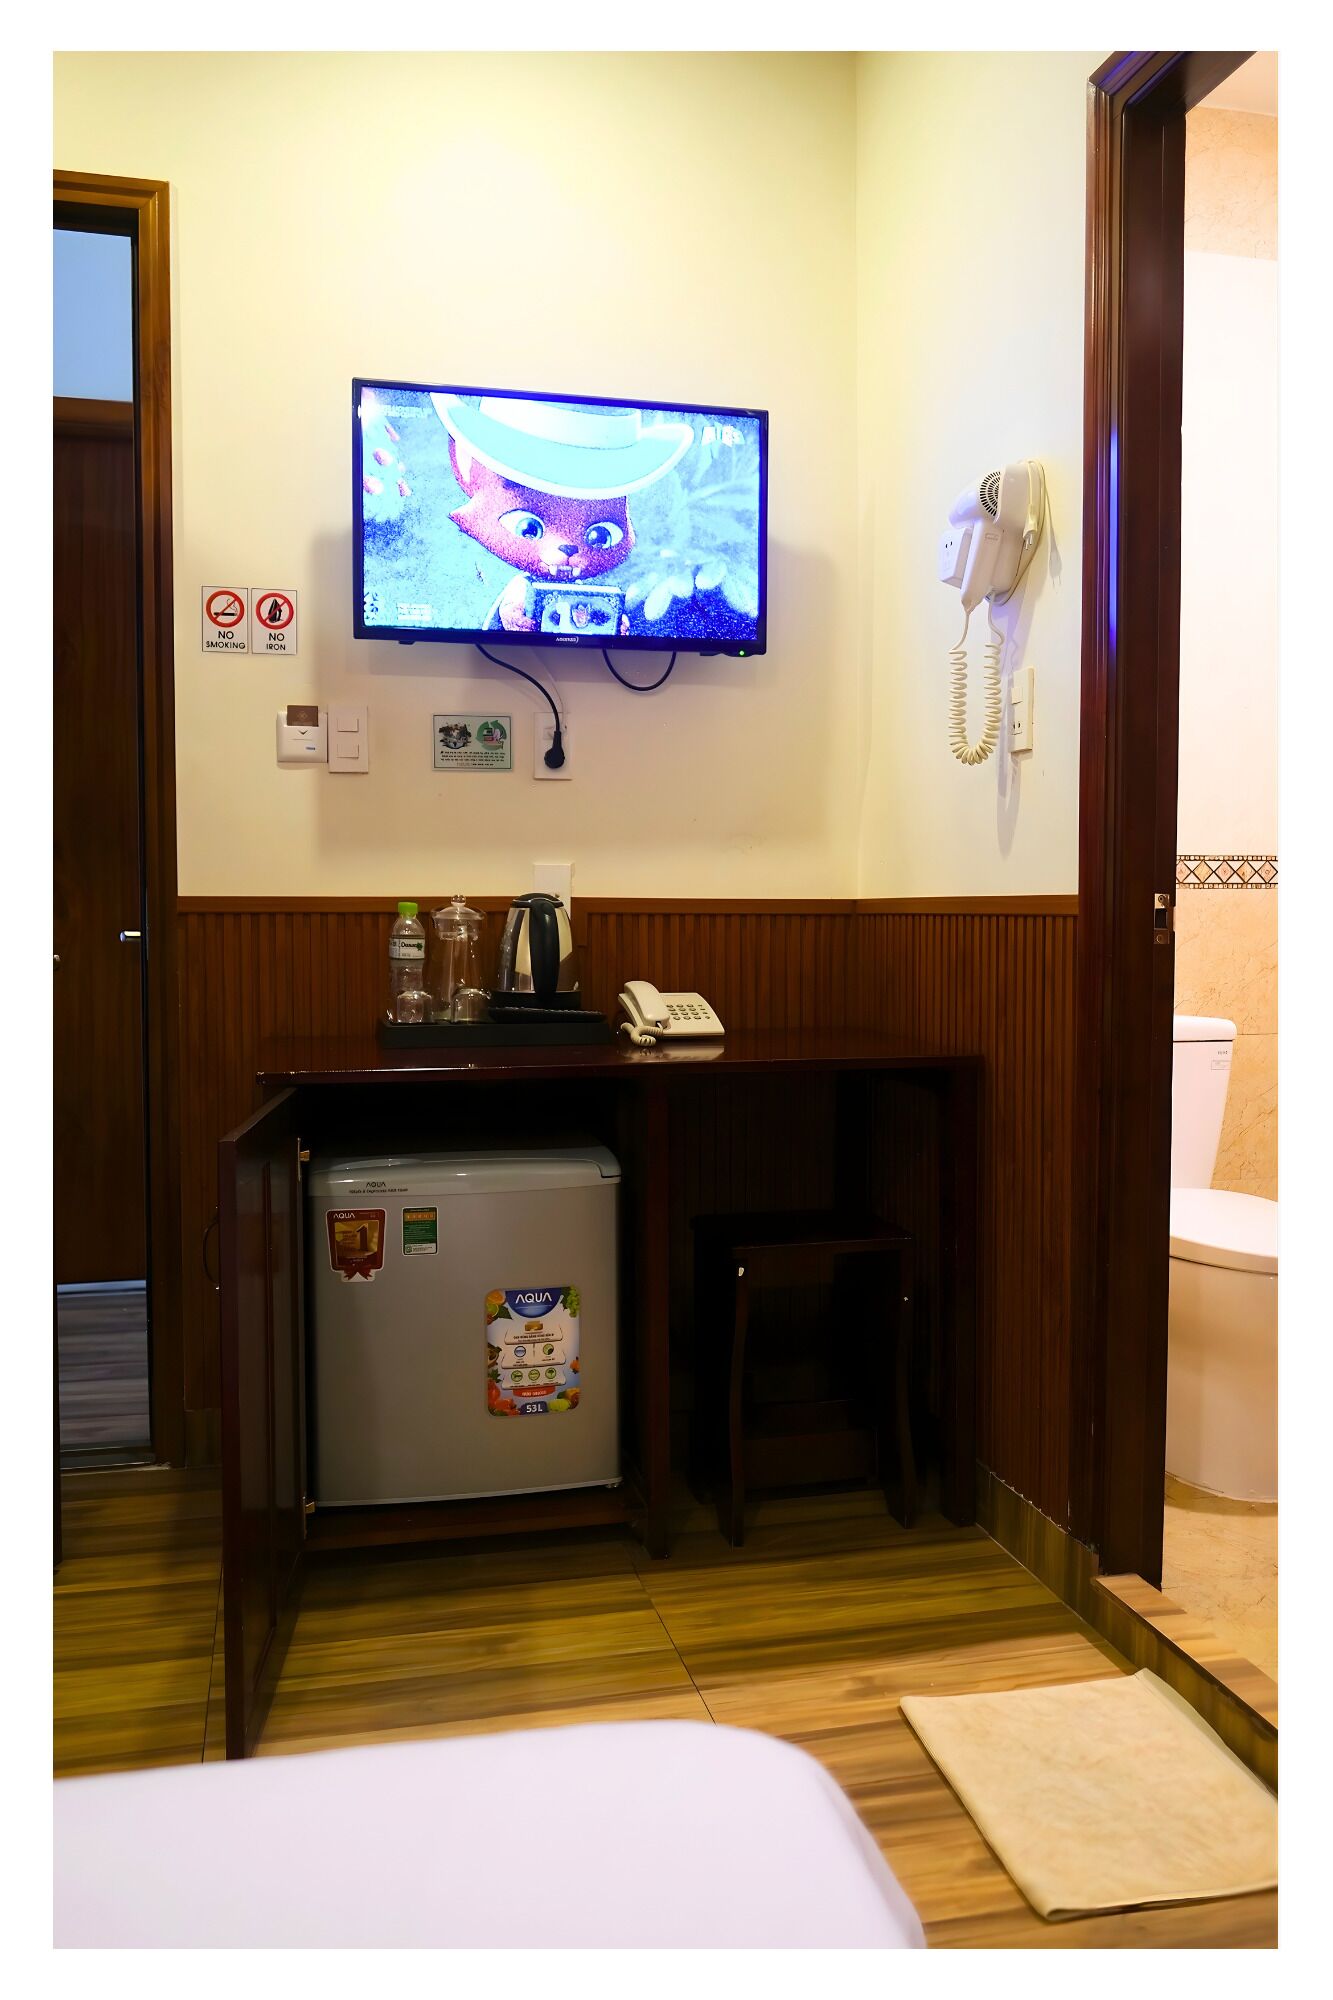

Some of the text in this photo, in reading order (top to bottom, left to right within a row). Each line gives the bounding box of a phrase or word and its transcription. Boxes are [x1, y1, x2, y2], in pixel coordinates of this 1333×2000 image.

[218, 631, 234, 639] NO
[269, 633, 285, 641] NO
[206, 641, 245, 649] SMOKING
[266, 643, 286, 651] IRON
[515, 1292, 552, 1304] AQUA
